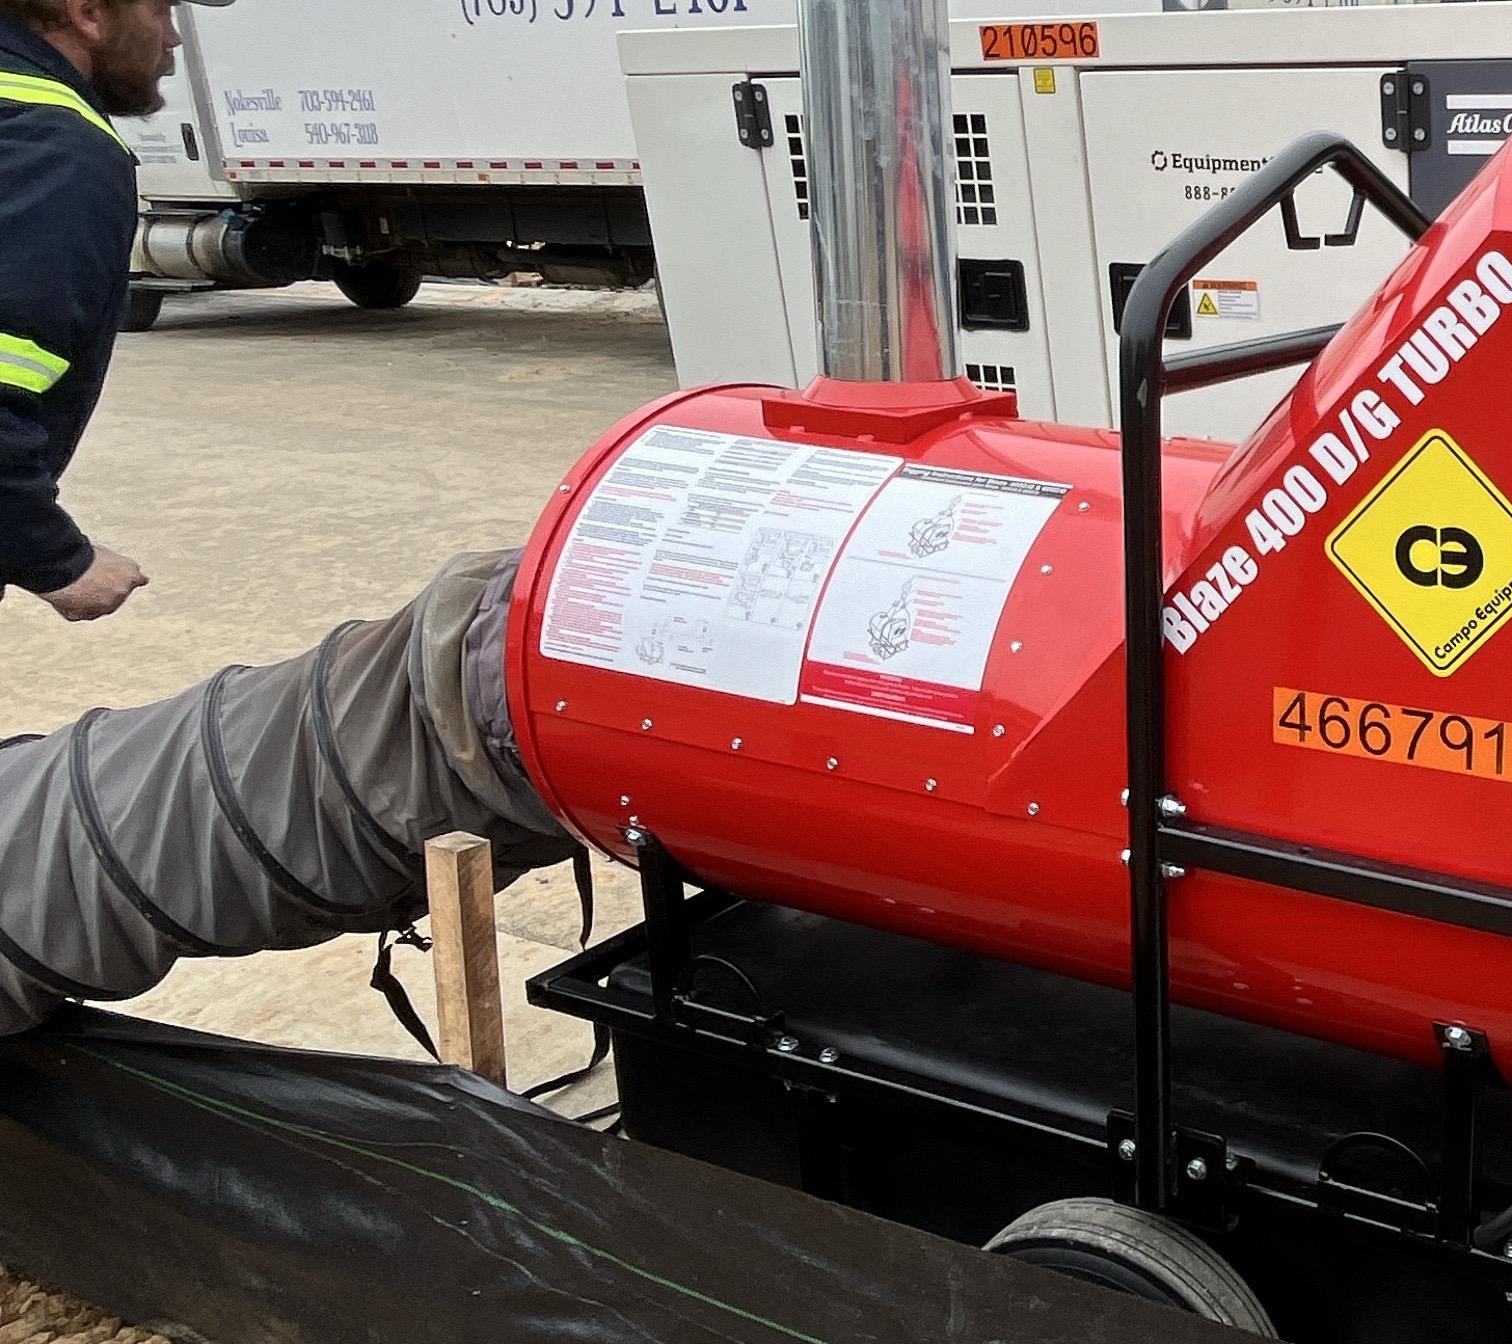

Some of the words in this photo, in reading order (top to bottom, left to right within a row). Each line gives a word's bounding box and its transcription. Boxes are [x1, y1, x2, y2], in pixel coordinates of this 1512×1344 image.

[982, 22, 1097, 58] 210596
[298, 89, 376, 112] 703-594-2461
[1446, 112, 1502, 134] Atlas
[1163, 545, 1259, 656] Blaze
[1244, 464, 1328, 557] 400
[1308, 389, 1402, 487] D/G
[1434, 619, 1479, 659] Campo
[1278, 692, 1506, 776] 466791
